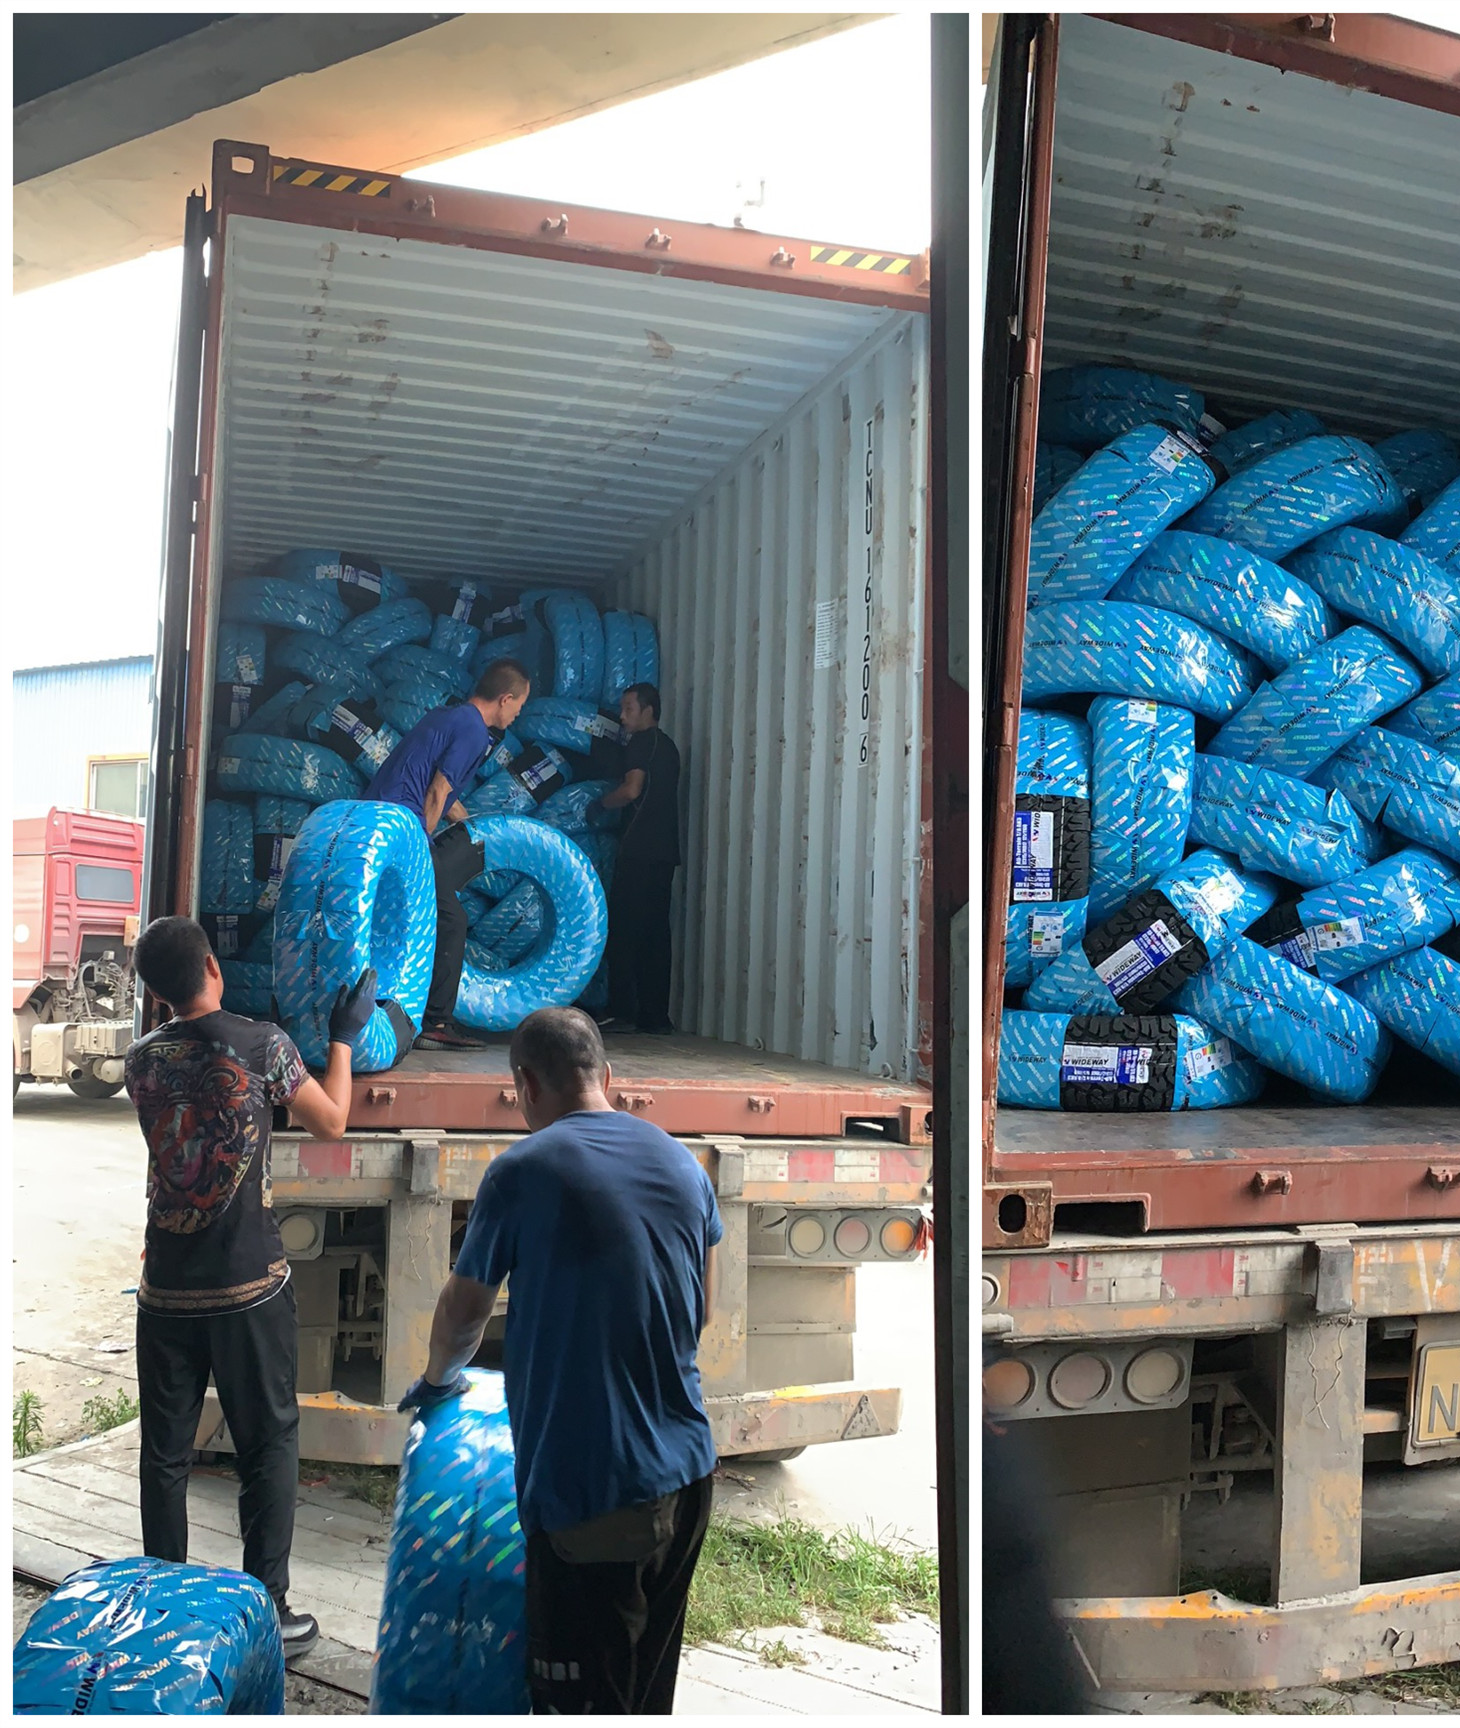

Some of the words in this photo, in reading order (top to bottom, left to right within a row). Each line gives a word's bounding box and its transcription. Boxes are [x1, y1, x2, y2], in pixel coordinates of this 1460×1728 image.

[864, 420, 874, 536] TCNU
[1115, 483, 1142, 506] WIDEWAY
[1073, 518, 1098, 547] WIDEWAY
[1203, 577, 1237, 594] WIDEWAY
[1380, 568, 1408, 588] WIDEWAY
[861, 546, 873, 722] 161200
[1079, 640, 1114, 648] WIDEWAY
[859, 735, 868, 763] 6
[1381, 768, 1415, 787] WIDEWAY
[1430, 793, 1460, 812] WIDEWAY
[1257, 811, 1291, 826] WIDEWAY
[1130, 846, 1139, 879] WIDEWAY
[1112, 952, 1142, 977] WIDEWAY
[1221, 976, 1253, 995] WIDEWAY
[1276, 1003, 1307, 1022] WIDEWAY
[1326, 1031, 1351, 1050] WIDEWAY
[1071, 1058, 1109, 1066] WIDEWAY
